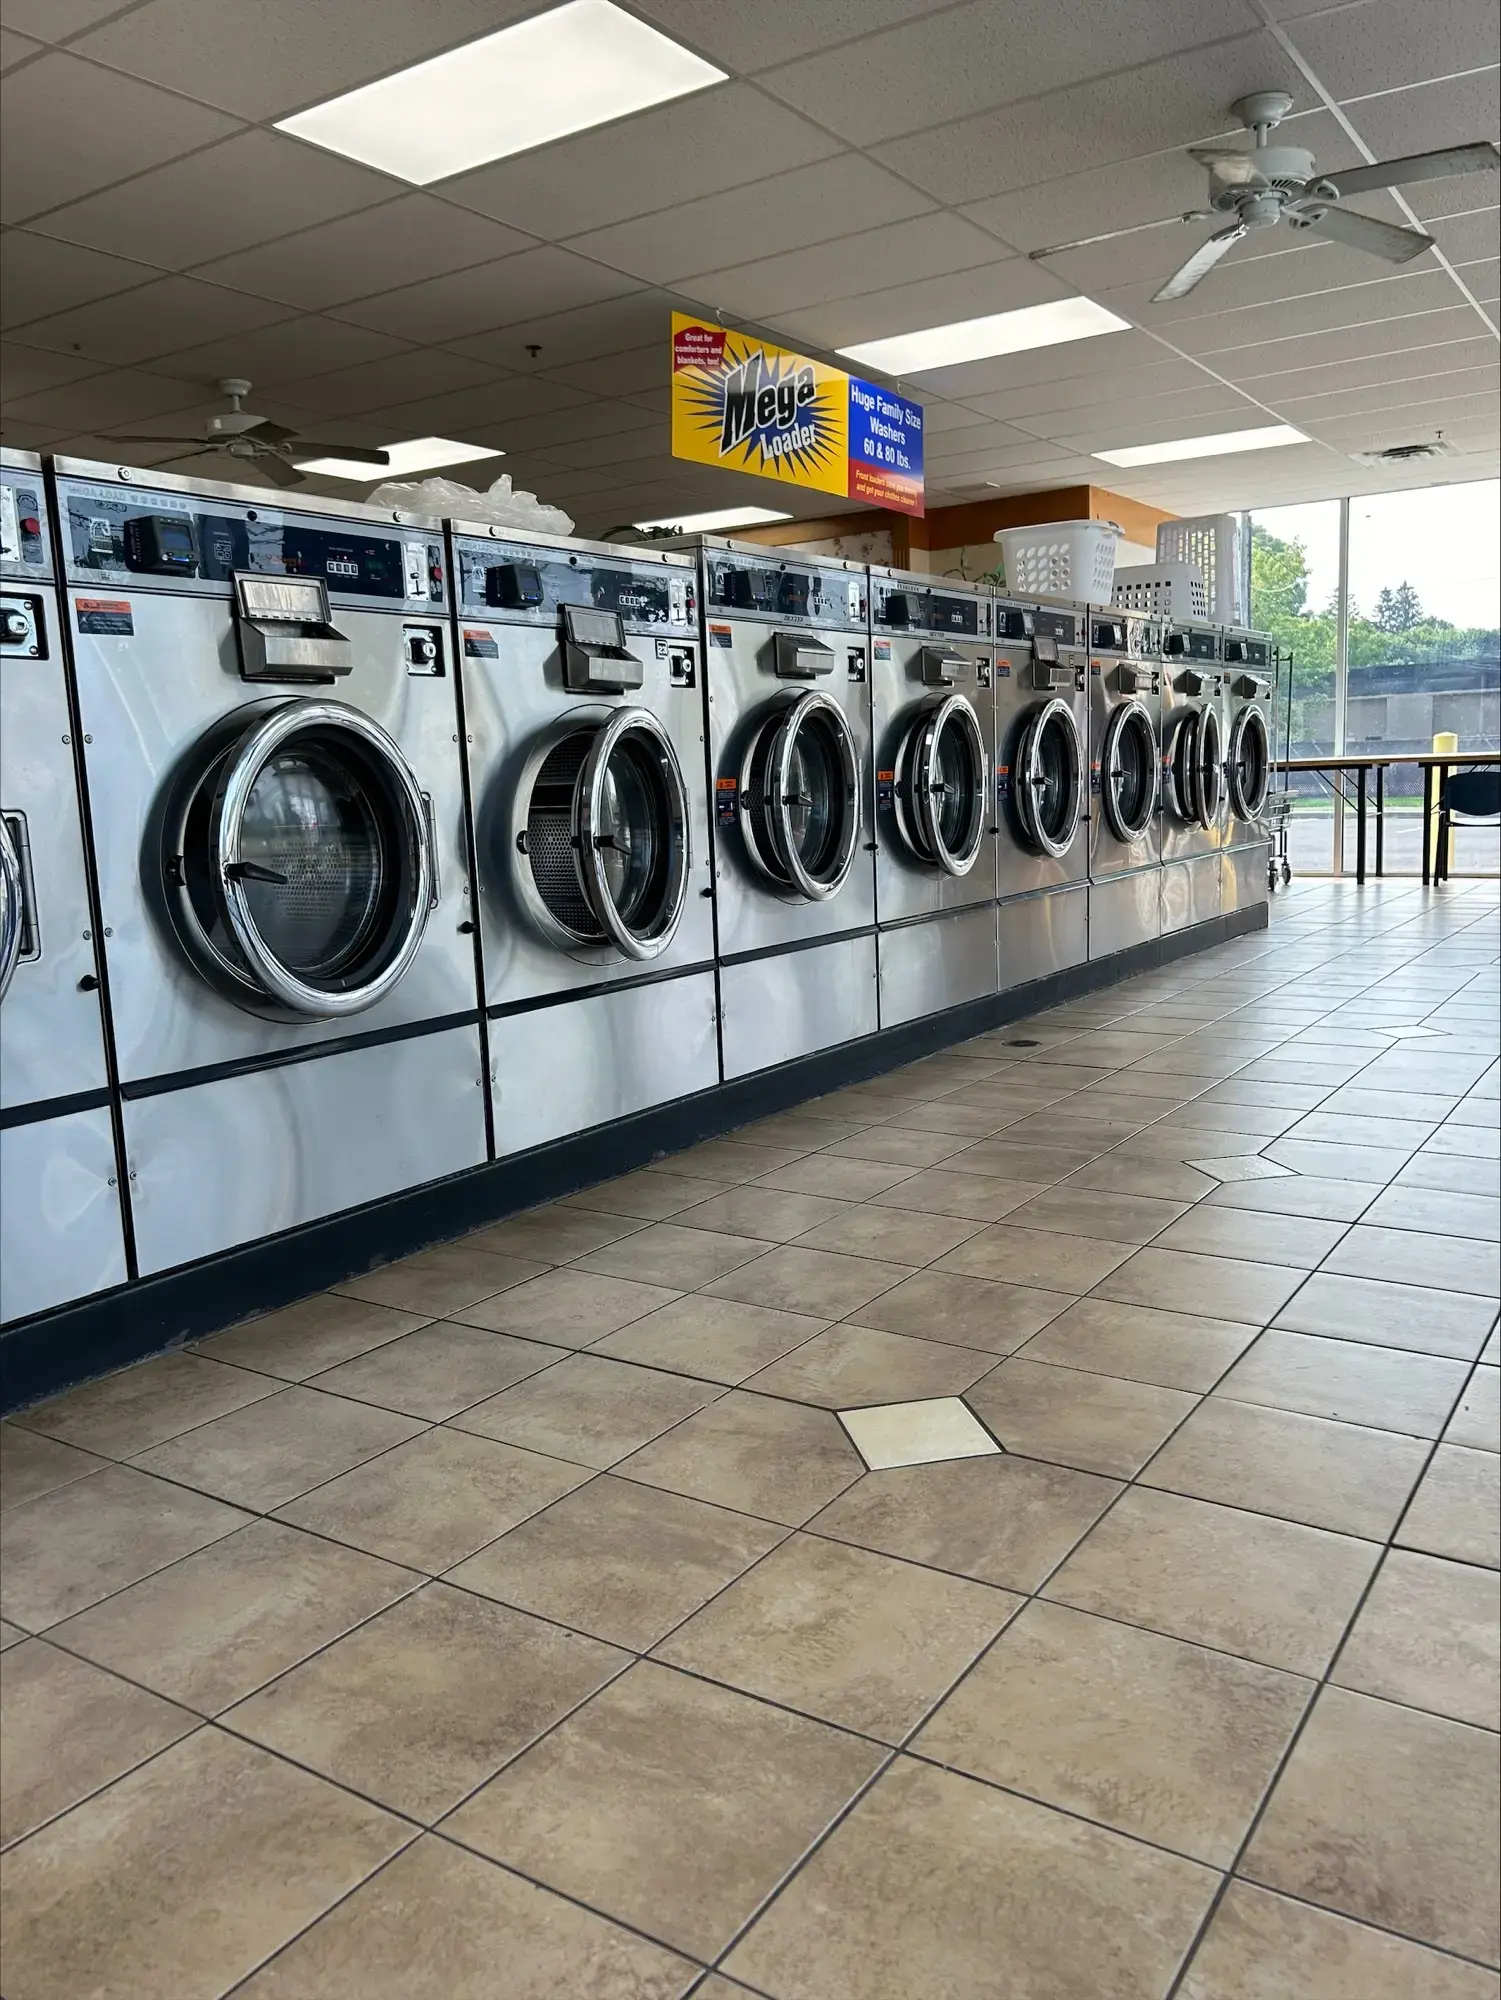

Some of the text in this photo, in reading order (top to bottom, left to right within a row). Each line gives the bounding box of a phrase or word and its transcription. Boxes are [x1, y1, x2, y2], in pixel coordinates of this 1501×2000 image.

[674, 345, 722, 354] comforters and
[684, 333, 714, 343] Great for
[676, 355, 720, 366] blankets, too!
[719, 349, 816, 459] Mega
[851, 384, 921, 430] Huge Family Size
[760, 422, 816, 460] Loader
[870, 416, 906, 445] Washers
[864, 438, 911, 469] 60 & 80 lbs.
[856, 469, 868, 481] Front
[869, 473, 886, 486] loaders
[856, 483, 866, 492] and
[866, 486, 874, 496] get
[874, 489, 884, 498] your
[884, 491, 900, 502] clothes
